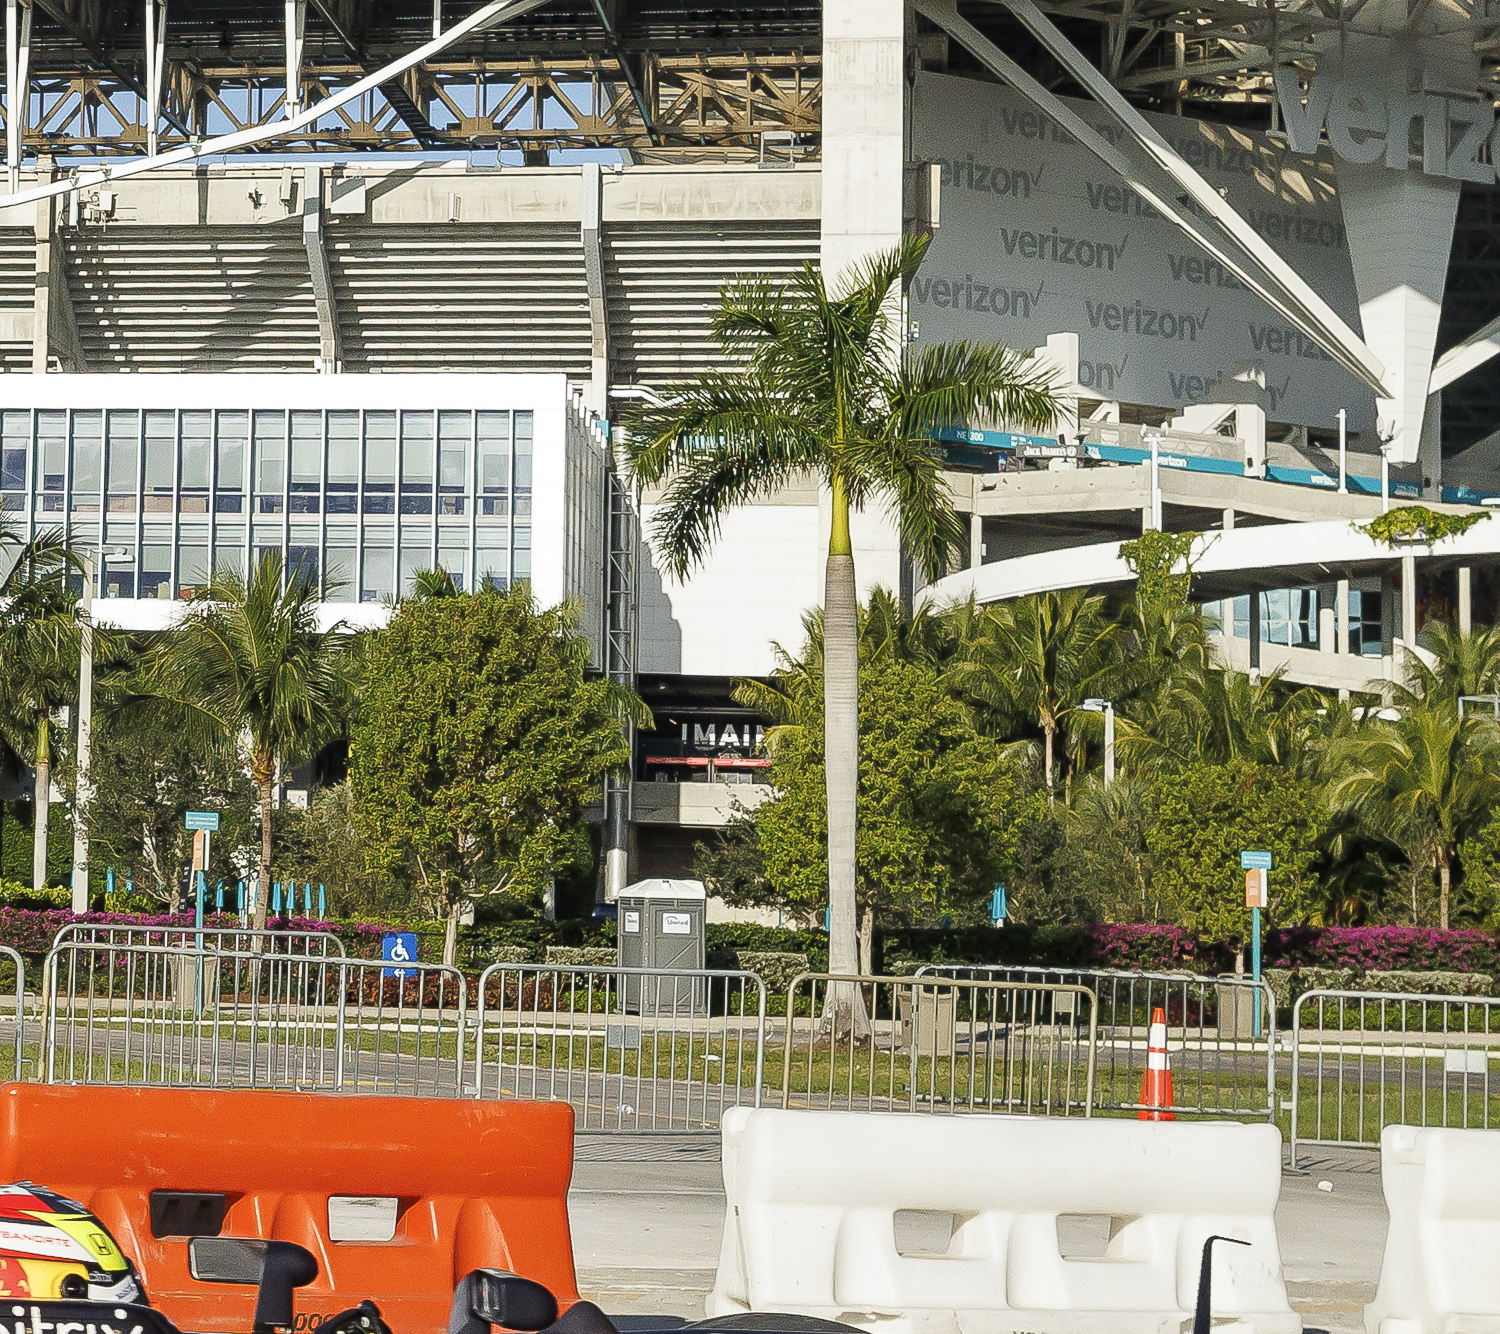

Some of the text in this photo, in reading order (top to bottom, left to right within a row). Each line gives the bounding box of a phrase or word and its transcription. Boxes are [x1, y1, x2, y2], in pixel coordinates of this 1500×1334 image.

[1001, 226, 1114, 271] verizon
[914, 274, 1031, 318] verizon
[1086, 298, 1198, 342] verizon
